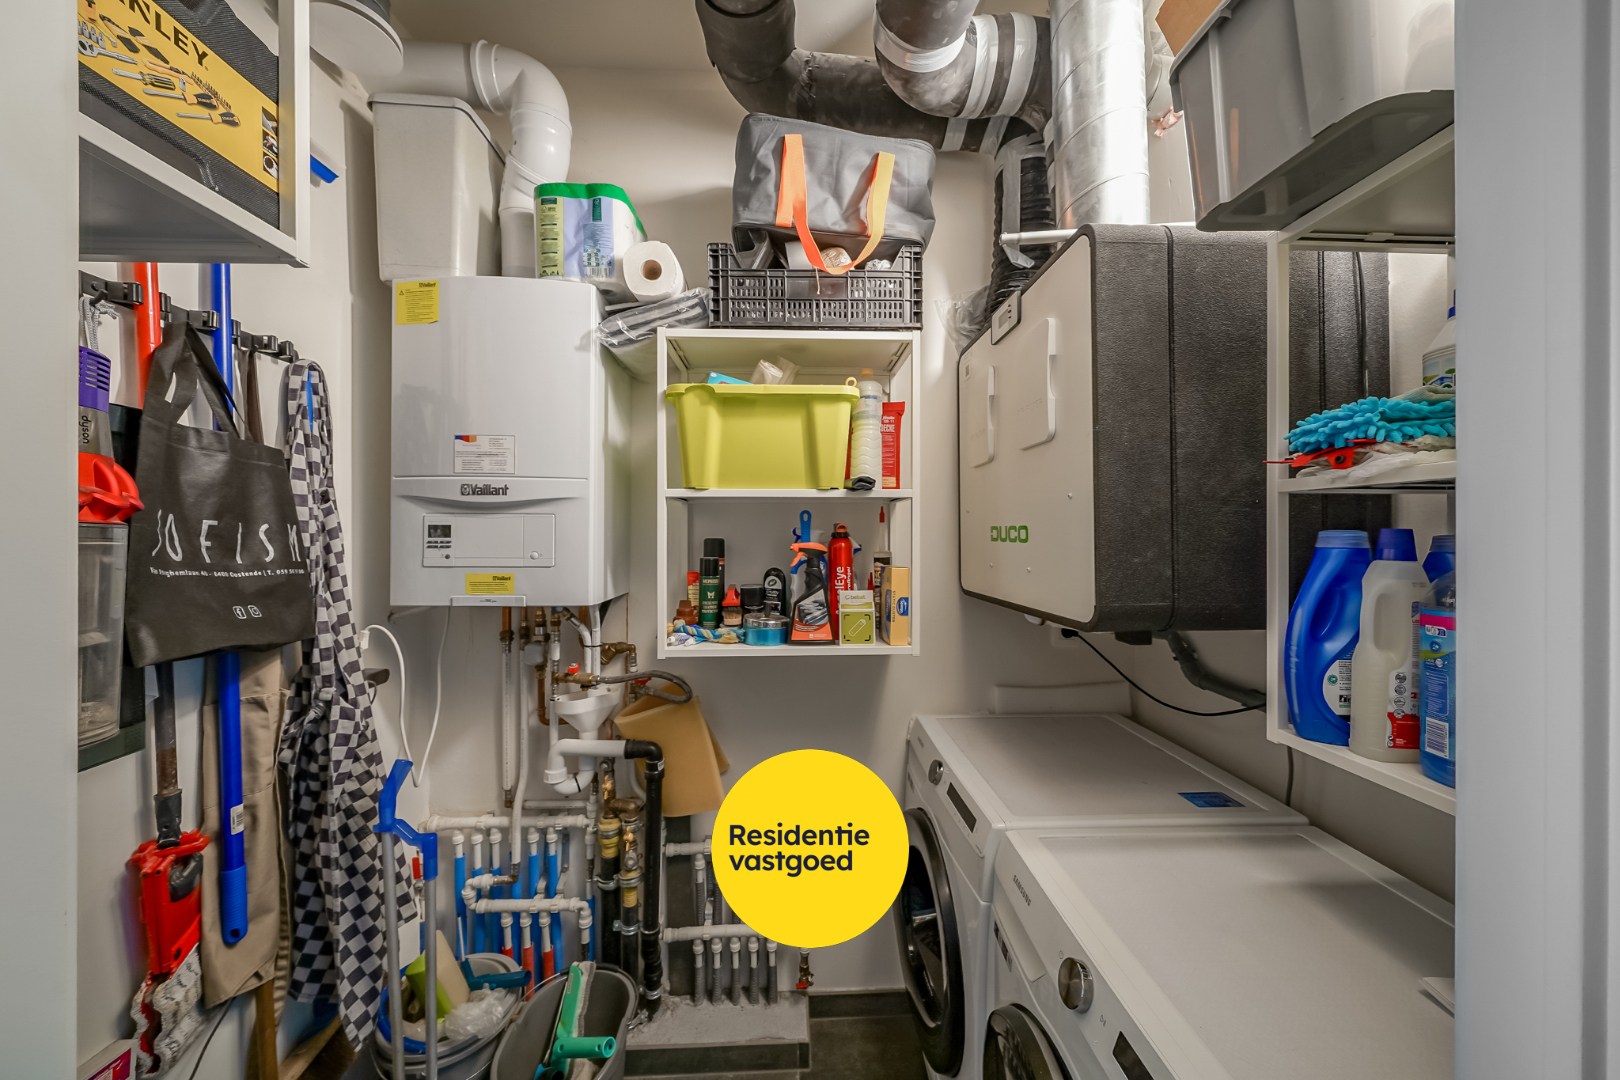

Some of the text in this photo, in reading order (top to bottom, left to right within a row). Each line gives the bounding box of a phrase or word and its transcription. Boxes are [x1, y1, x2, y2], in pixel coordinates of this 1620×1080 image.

[121, 0, 208, 66] NLEY
[79, 415, 91, 444] dyson
[471, 483, 509, 496] Vaillant
[990, 525, 1029, 543] DUCO
